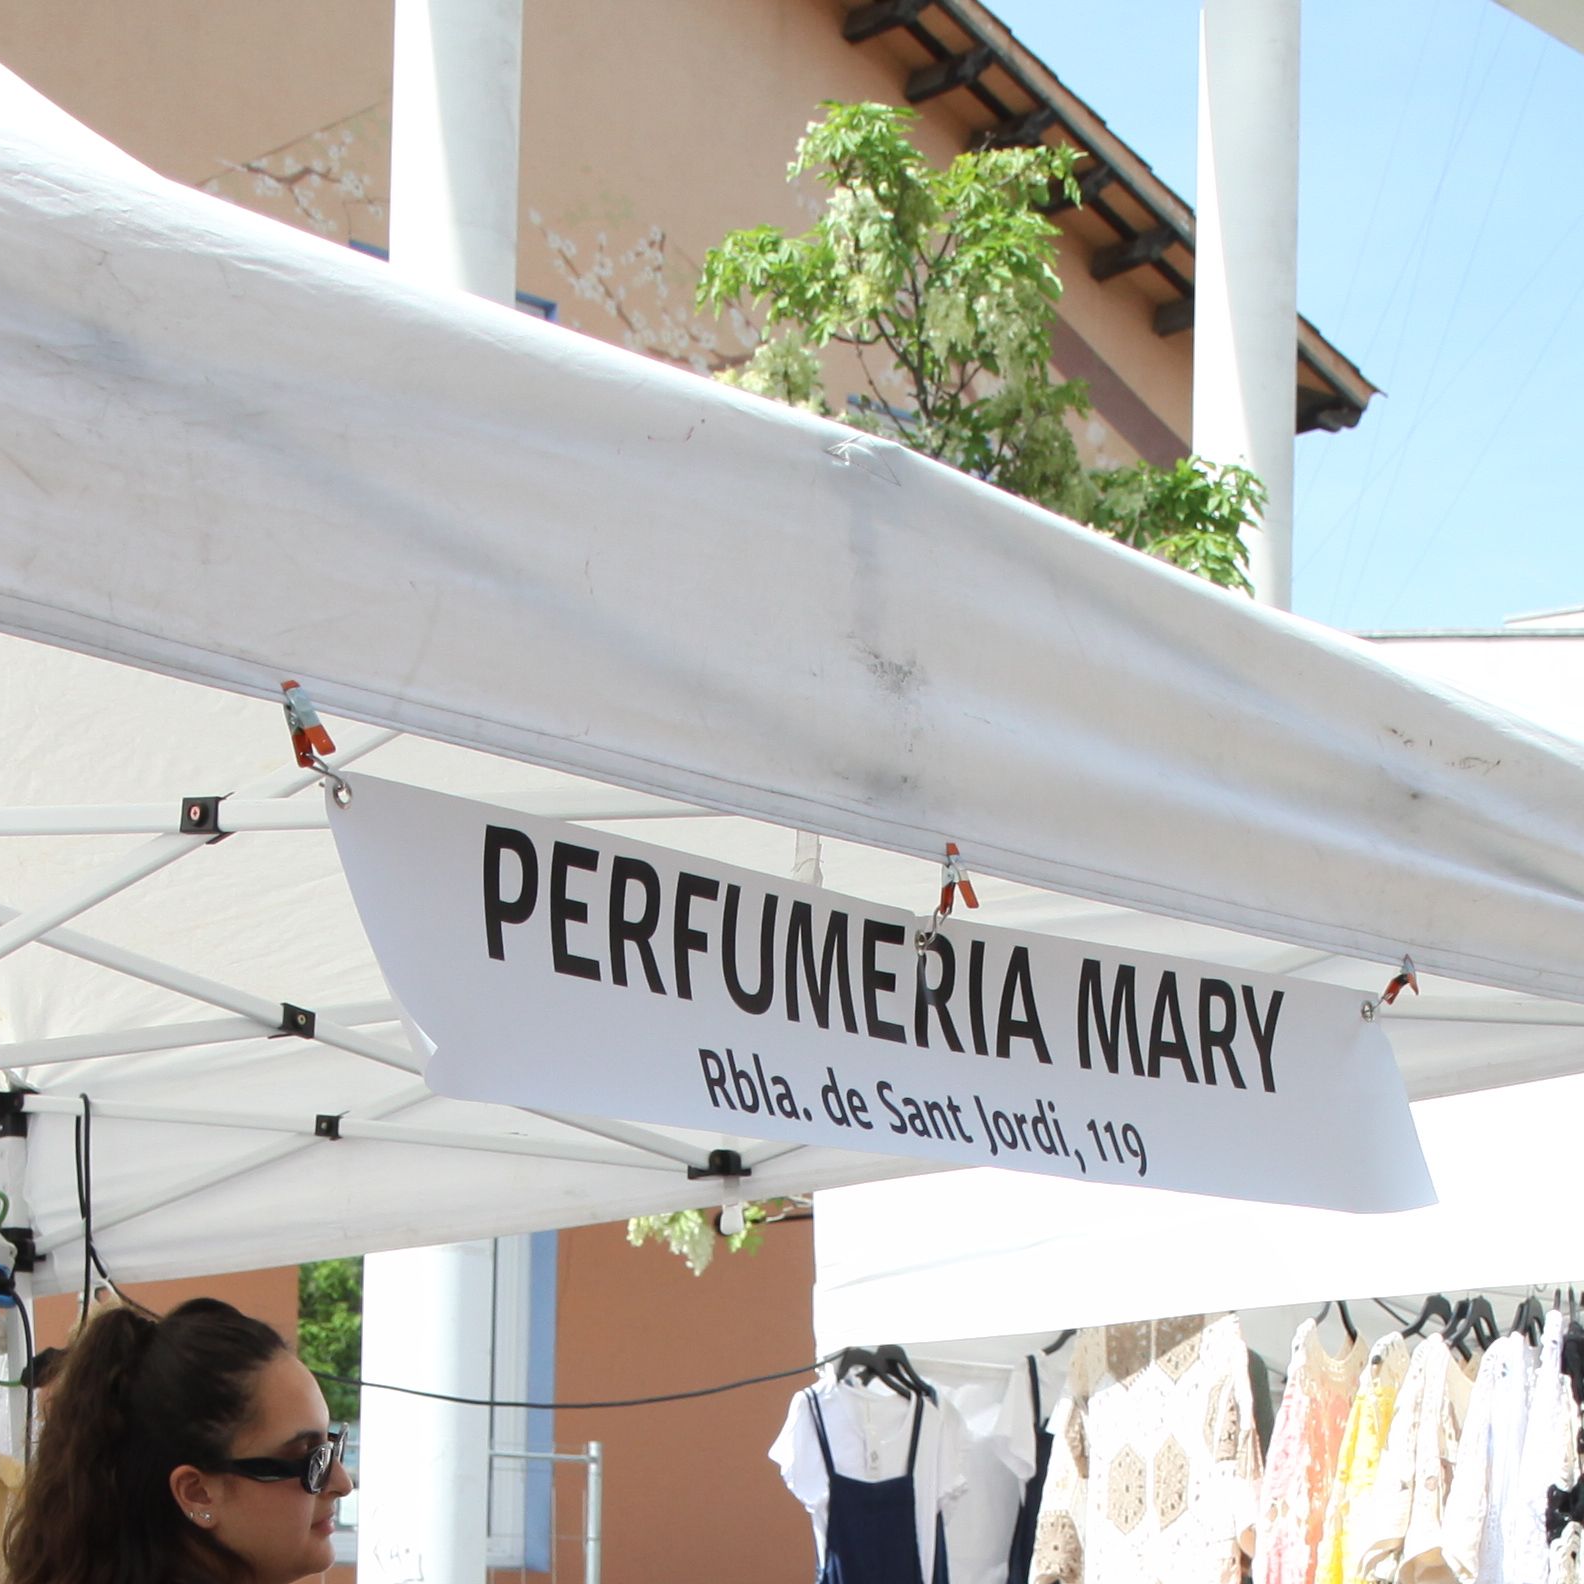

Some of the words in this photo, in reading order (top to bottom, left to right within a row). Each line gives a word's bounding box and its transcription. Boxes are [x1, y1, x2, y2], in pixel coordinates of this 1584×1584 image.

[482, 824, 1050, 1064] PERFUMERIA
[1077, 957, 1287, 1095] MARY
[698, 1047, 811, 1123] Rbla.
[820, 1066, 873, 1131] de
[887, 1078, 975, 1144] Sant
[975, 1090, 1085, 1173] Jordi,
[1086, 1117, 1149, 1178] 119
